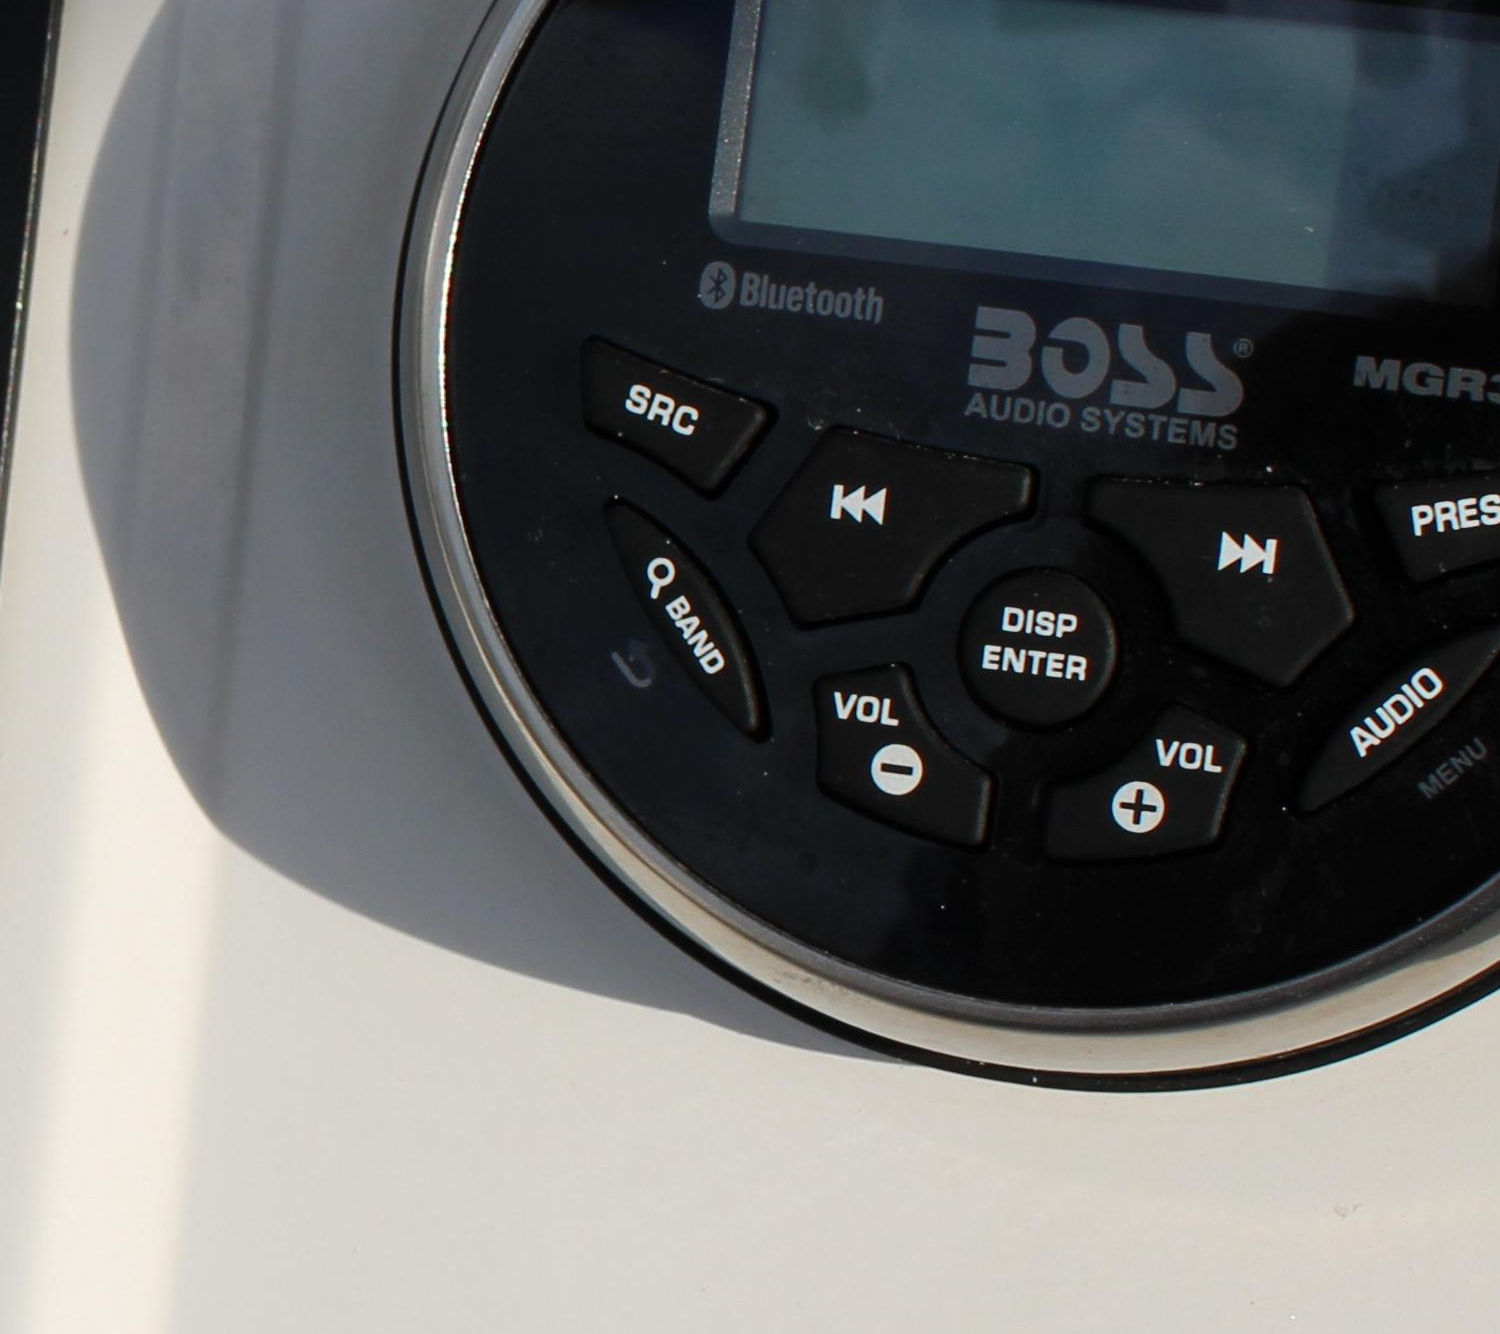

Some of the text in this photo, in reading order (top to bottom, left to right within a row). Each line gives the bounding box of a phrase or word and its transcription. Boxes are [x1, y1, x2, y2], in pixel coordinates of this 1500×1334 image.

[739, 271, 883, 324] Bluetooth
[625, 384, 699, 436] SRC
[964, 392, 1239, 450] AUDIO SYSTEMS
[665, 596, 725, 675] BAND
[1002, 607, 1078, 638] DISP
[982, 644, 1088, 681] ENTER
[834, 692, 900, 727] VOL
[1350, 668, 1444, 757] AUDIO
[1156, 739, 1222, 773] VOL
[1418, 741, 1488, 799] MENU
